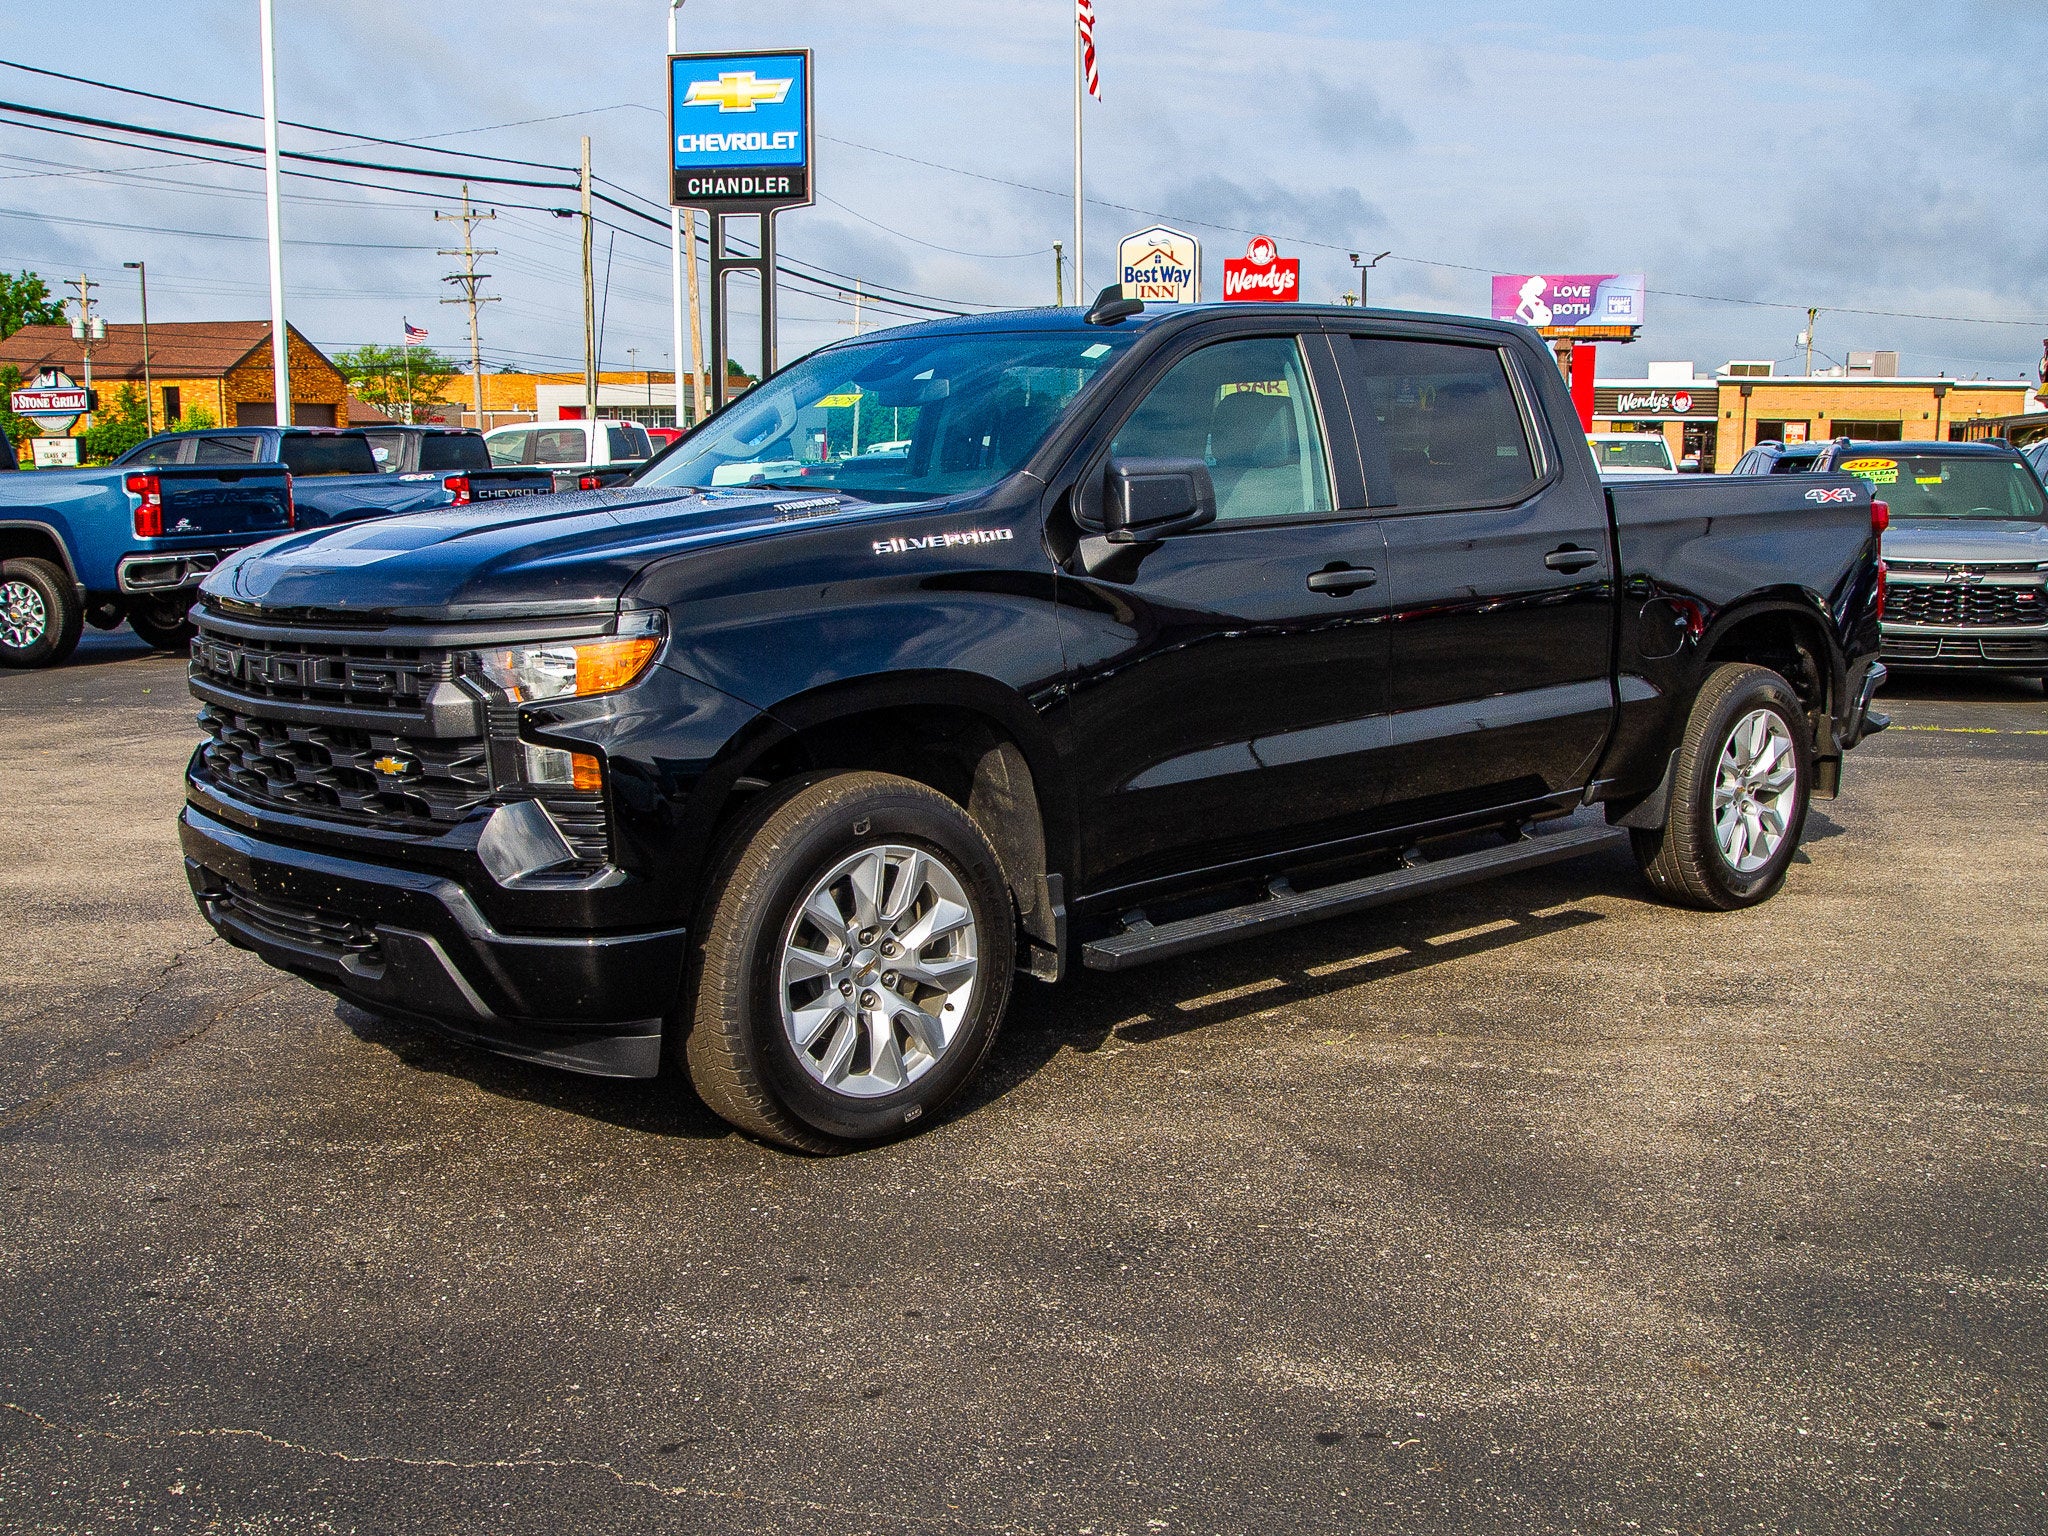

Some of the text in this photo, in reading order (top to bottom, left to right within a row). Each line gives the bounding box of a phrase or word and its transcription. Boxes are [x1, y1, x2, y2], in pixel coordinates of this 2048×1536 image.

[677, 131, 798, 152] CHEVROLET
[687, 176, 790, 195] CHANDLER
[1124, 266, 1192, 288] Best Way
[1226, 264, 1296, 296] Wendy's
[1140, 285, 1174, 298] INN
[1553, 285, 1591, 298] LOVE
[1552, 303, 1591, 315] BOTH
[18, 395, 50, 409] STONE
[1617, 390, 1669, 413] Wendy's
[1848, 461, 1891, 469] 2024
[872, 528, 1014, 555] SILVERADO
